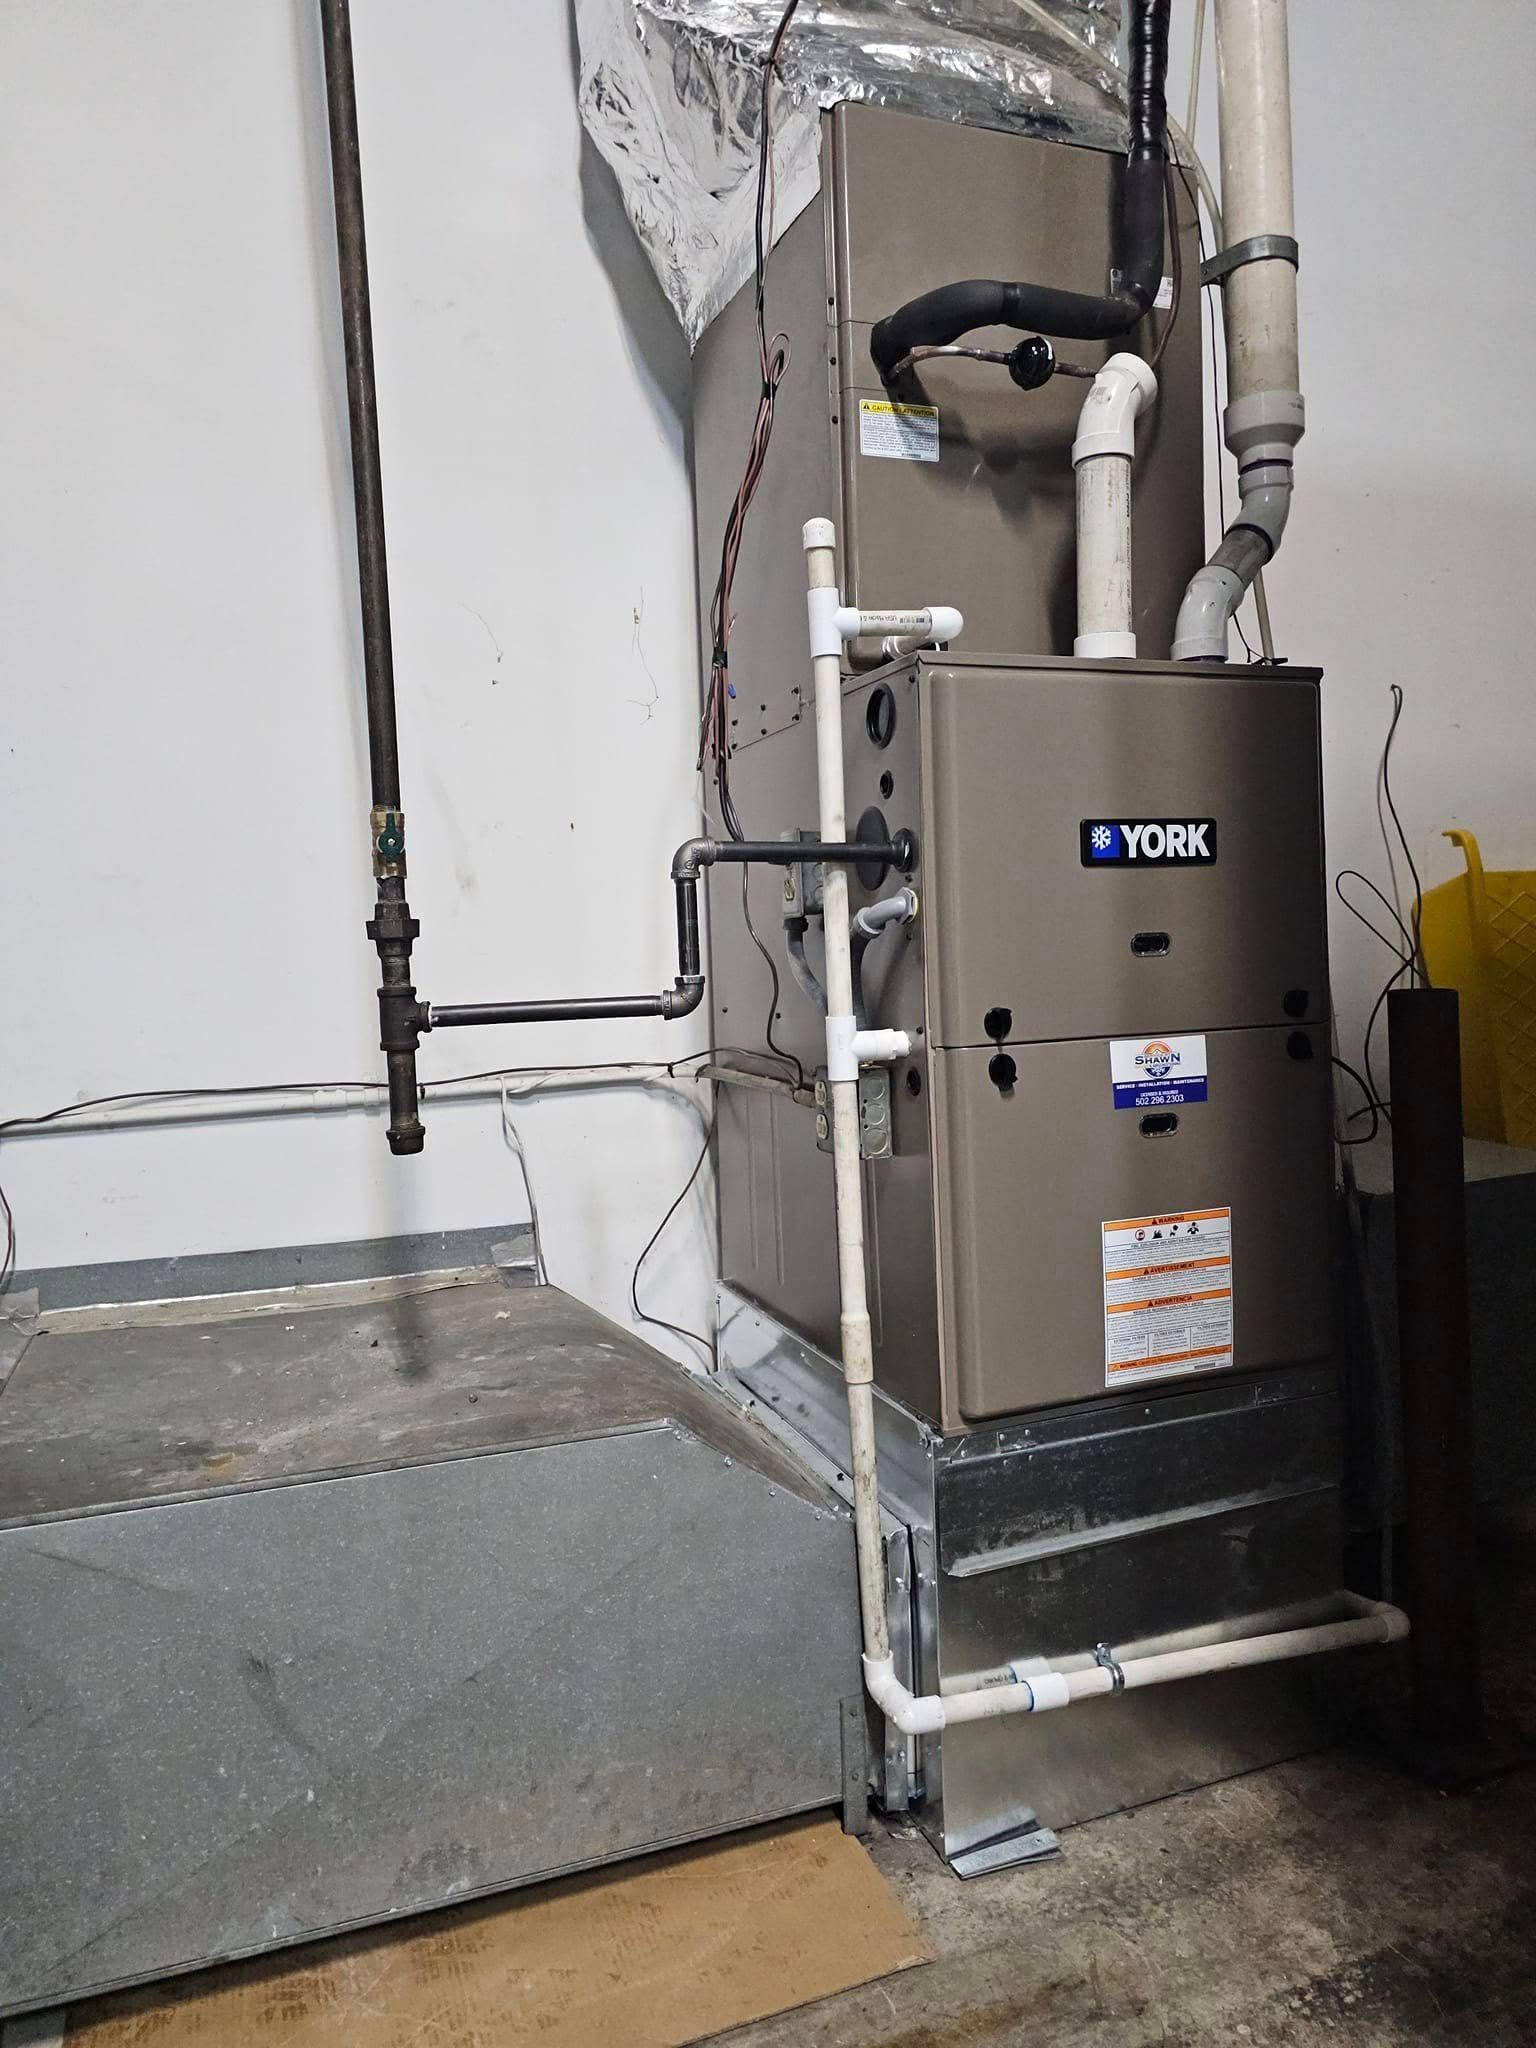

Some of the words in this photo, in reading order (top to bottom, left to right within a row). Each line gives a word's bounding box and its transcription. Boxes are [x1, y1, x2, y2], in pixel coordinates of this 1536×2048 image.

[871, 405, 898, 413] CAUTION
[1120, 824, 1210, 858] YORK
[1135, 1097, 1149, 1106] 502
[1166, 1093, 1184, 1104] 2303
[1158, 1215, 1184, 1223] WARNING
[1150, 1262, 1195, 1273] AVERTISSEMENT
[1152, 1295, 1193, 1306] ADVERTENCIA
